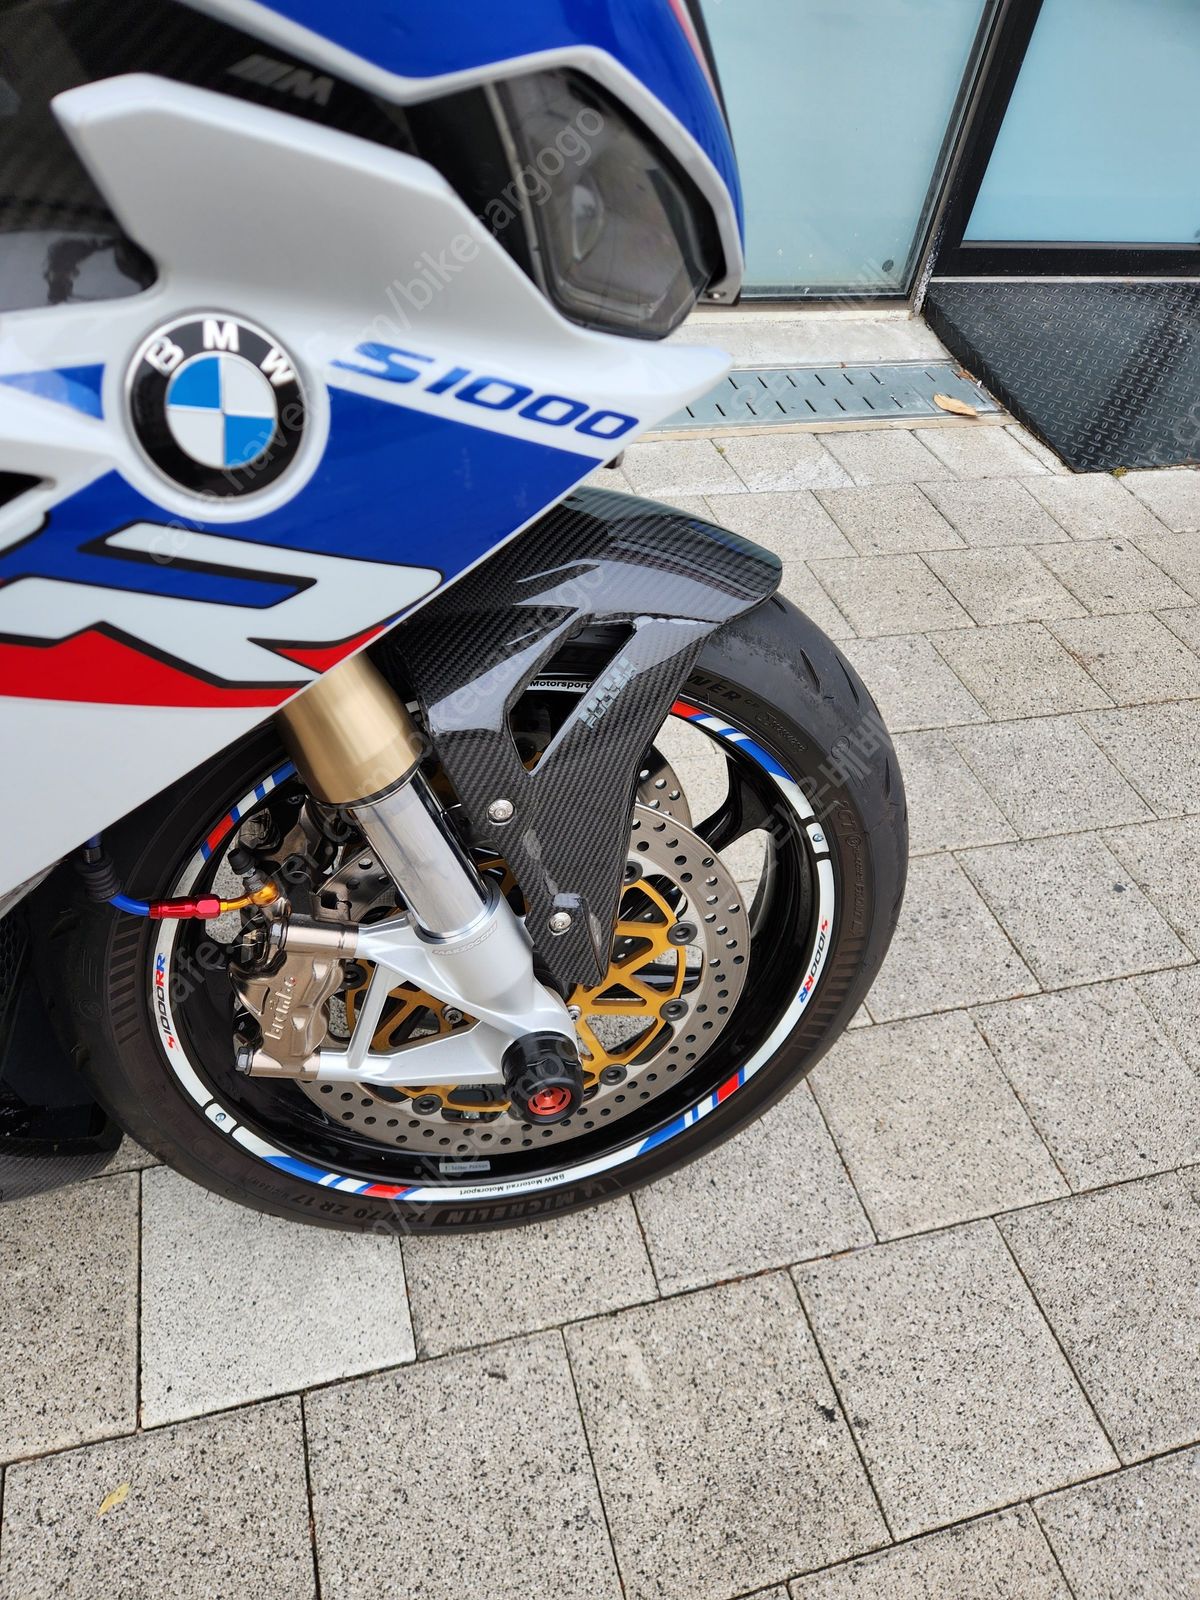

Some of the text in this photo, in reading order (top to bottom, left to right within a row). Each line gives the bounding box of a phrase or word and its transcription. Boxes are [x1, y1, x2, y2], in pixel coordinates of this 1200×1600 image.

[144, 319, 296, 388] BMW
[331, 341, 639, 440] S1000
[446, 1192, 577, 1226] MICHELIN
[459, 1173, 566, 1196] BMW Motorrad Motorsport
